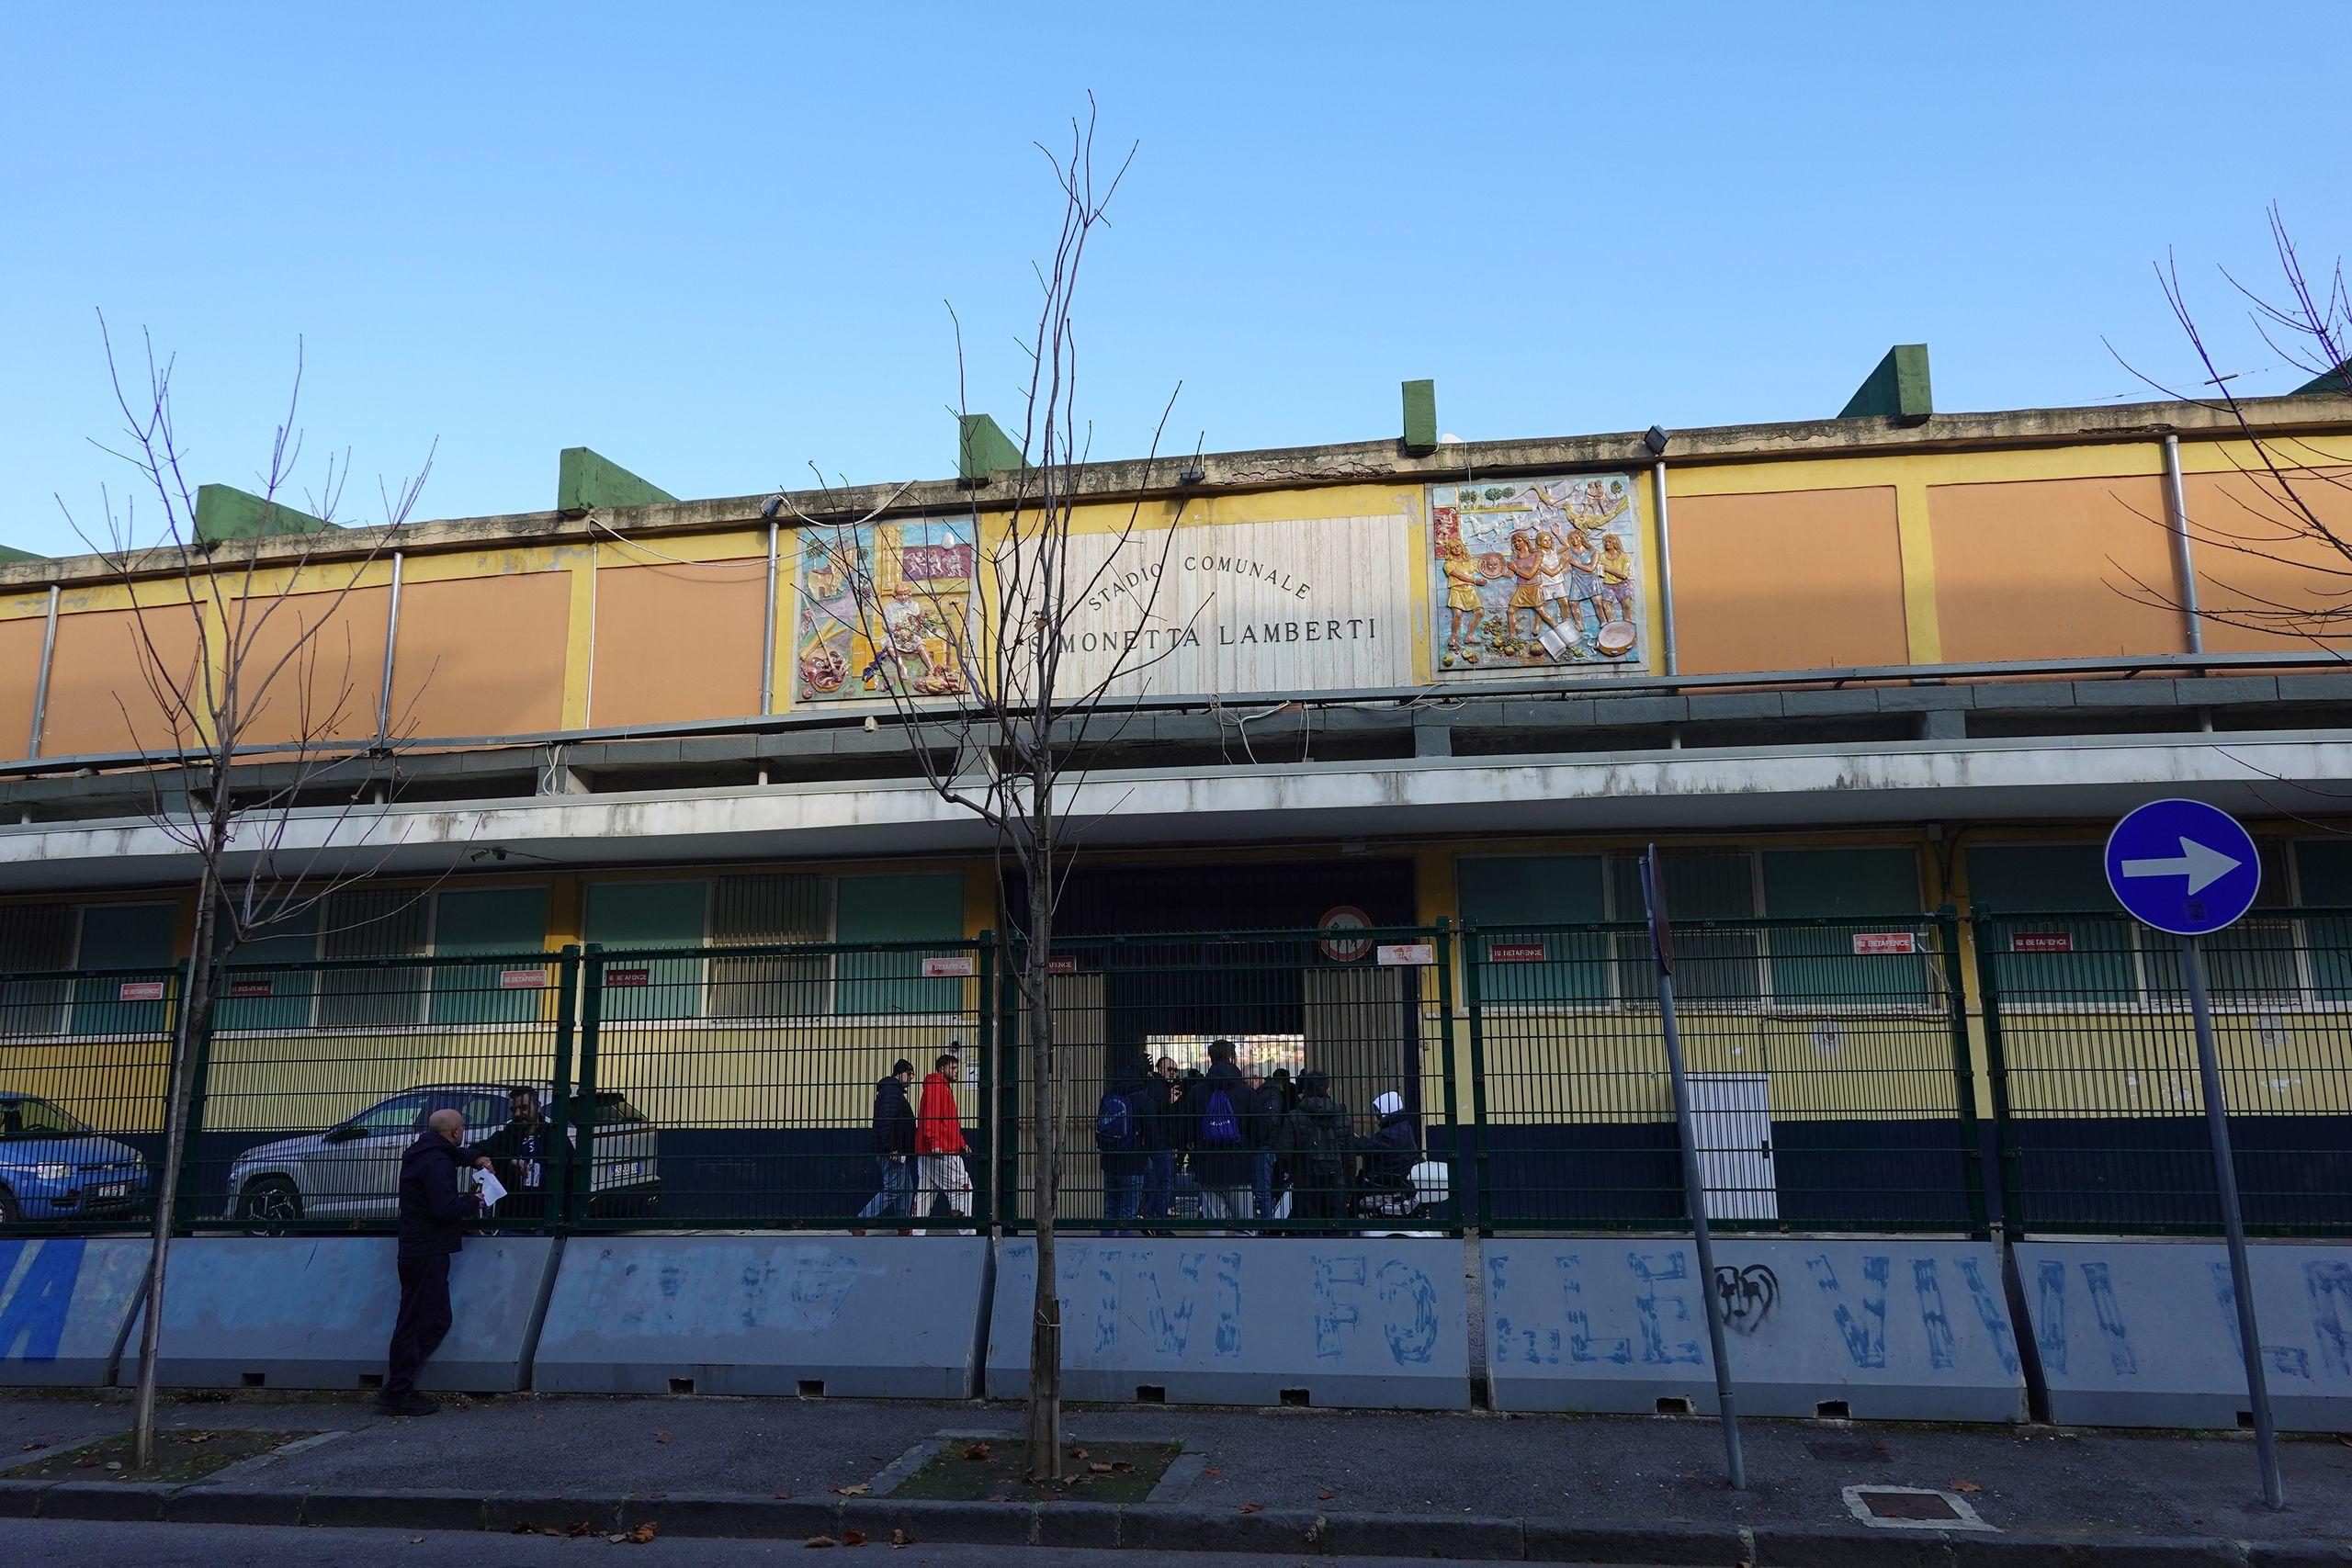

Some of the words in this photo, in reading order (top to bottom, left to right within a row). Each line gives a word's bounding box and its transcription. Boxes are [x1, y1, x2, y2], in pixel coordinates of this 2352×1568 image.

[1089, 563, 1162, 611] STADIO
[1184, 556, 1311, 600] COMUNALE
[1031, 627, 1201, 655] SMONETTA
[1219, 618, 1375, 646] LAMBERTI
